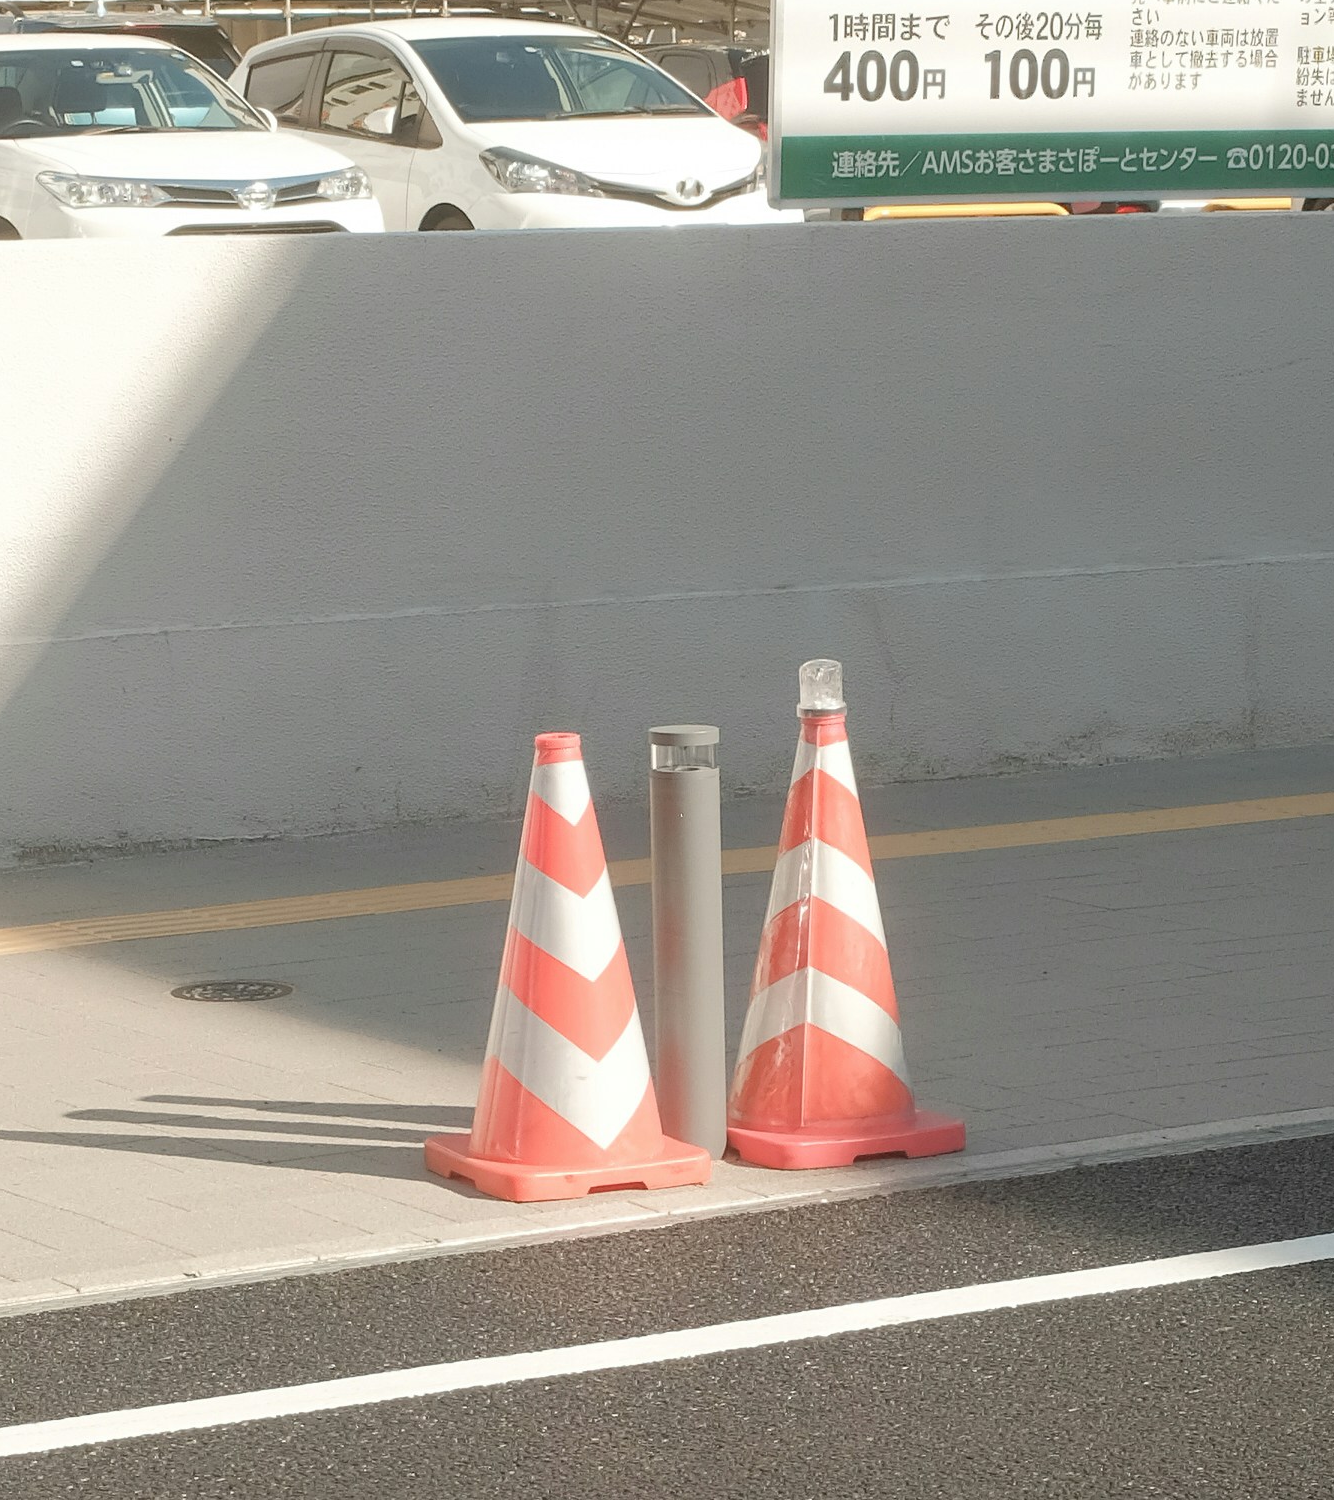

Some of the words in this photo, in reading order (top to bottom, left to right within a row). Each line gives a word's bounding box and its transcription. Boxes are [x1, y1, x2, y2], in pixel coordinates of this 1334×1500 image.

[829, 12, 951, 42] 1時間まで
[975, 12, 1103, 41] その後20分毎
[1132, 8, 1160, 26] さい
[1130, 28, 1279, 48] 連絡のない車両は放置
[1130, 49, 1278, 69] 車として撤去する場合
[823, 49, 946, 102] 400円
[984, 48, 1096, 100] 100円
[1128, 71, 1202, 90] があります
